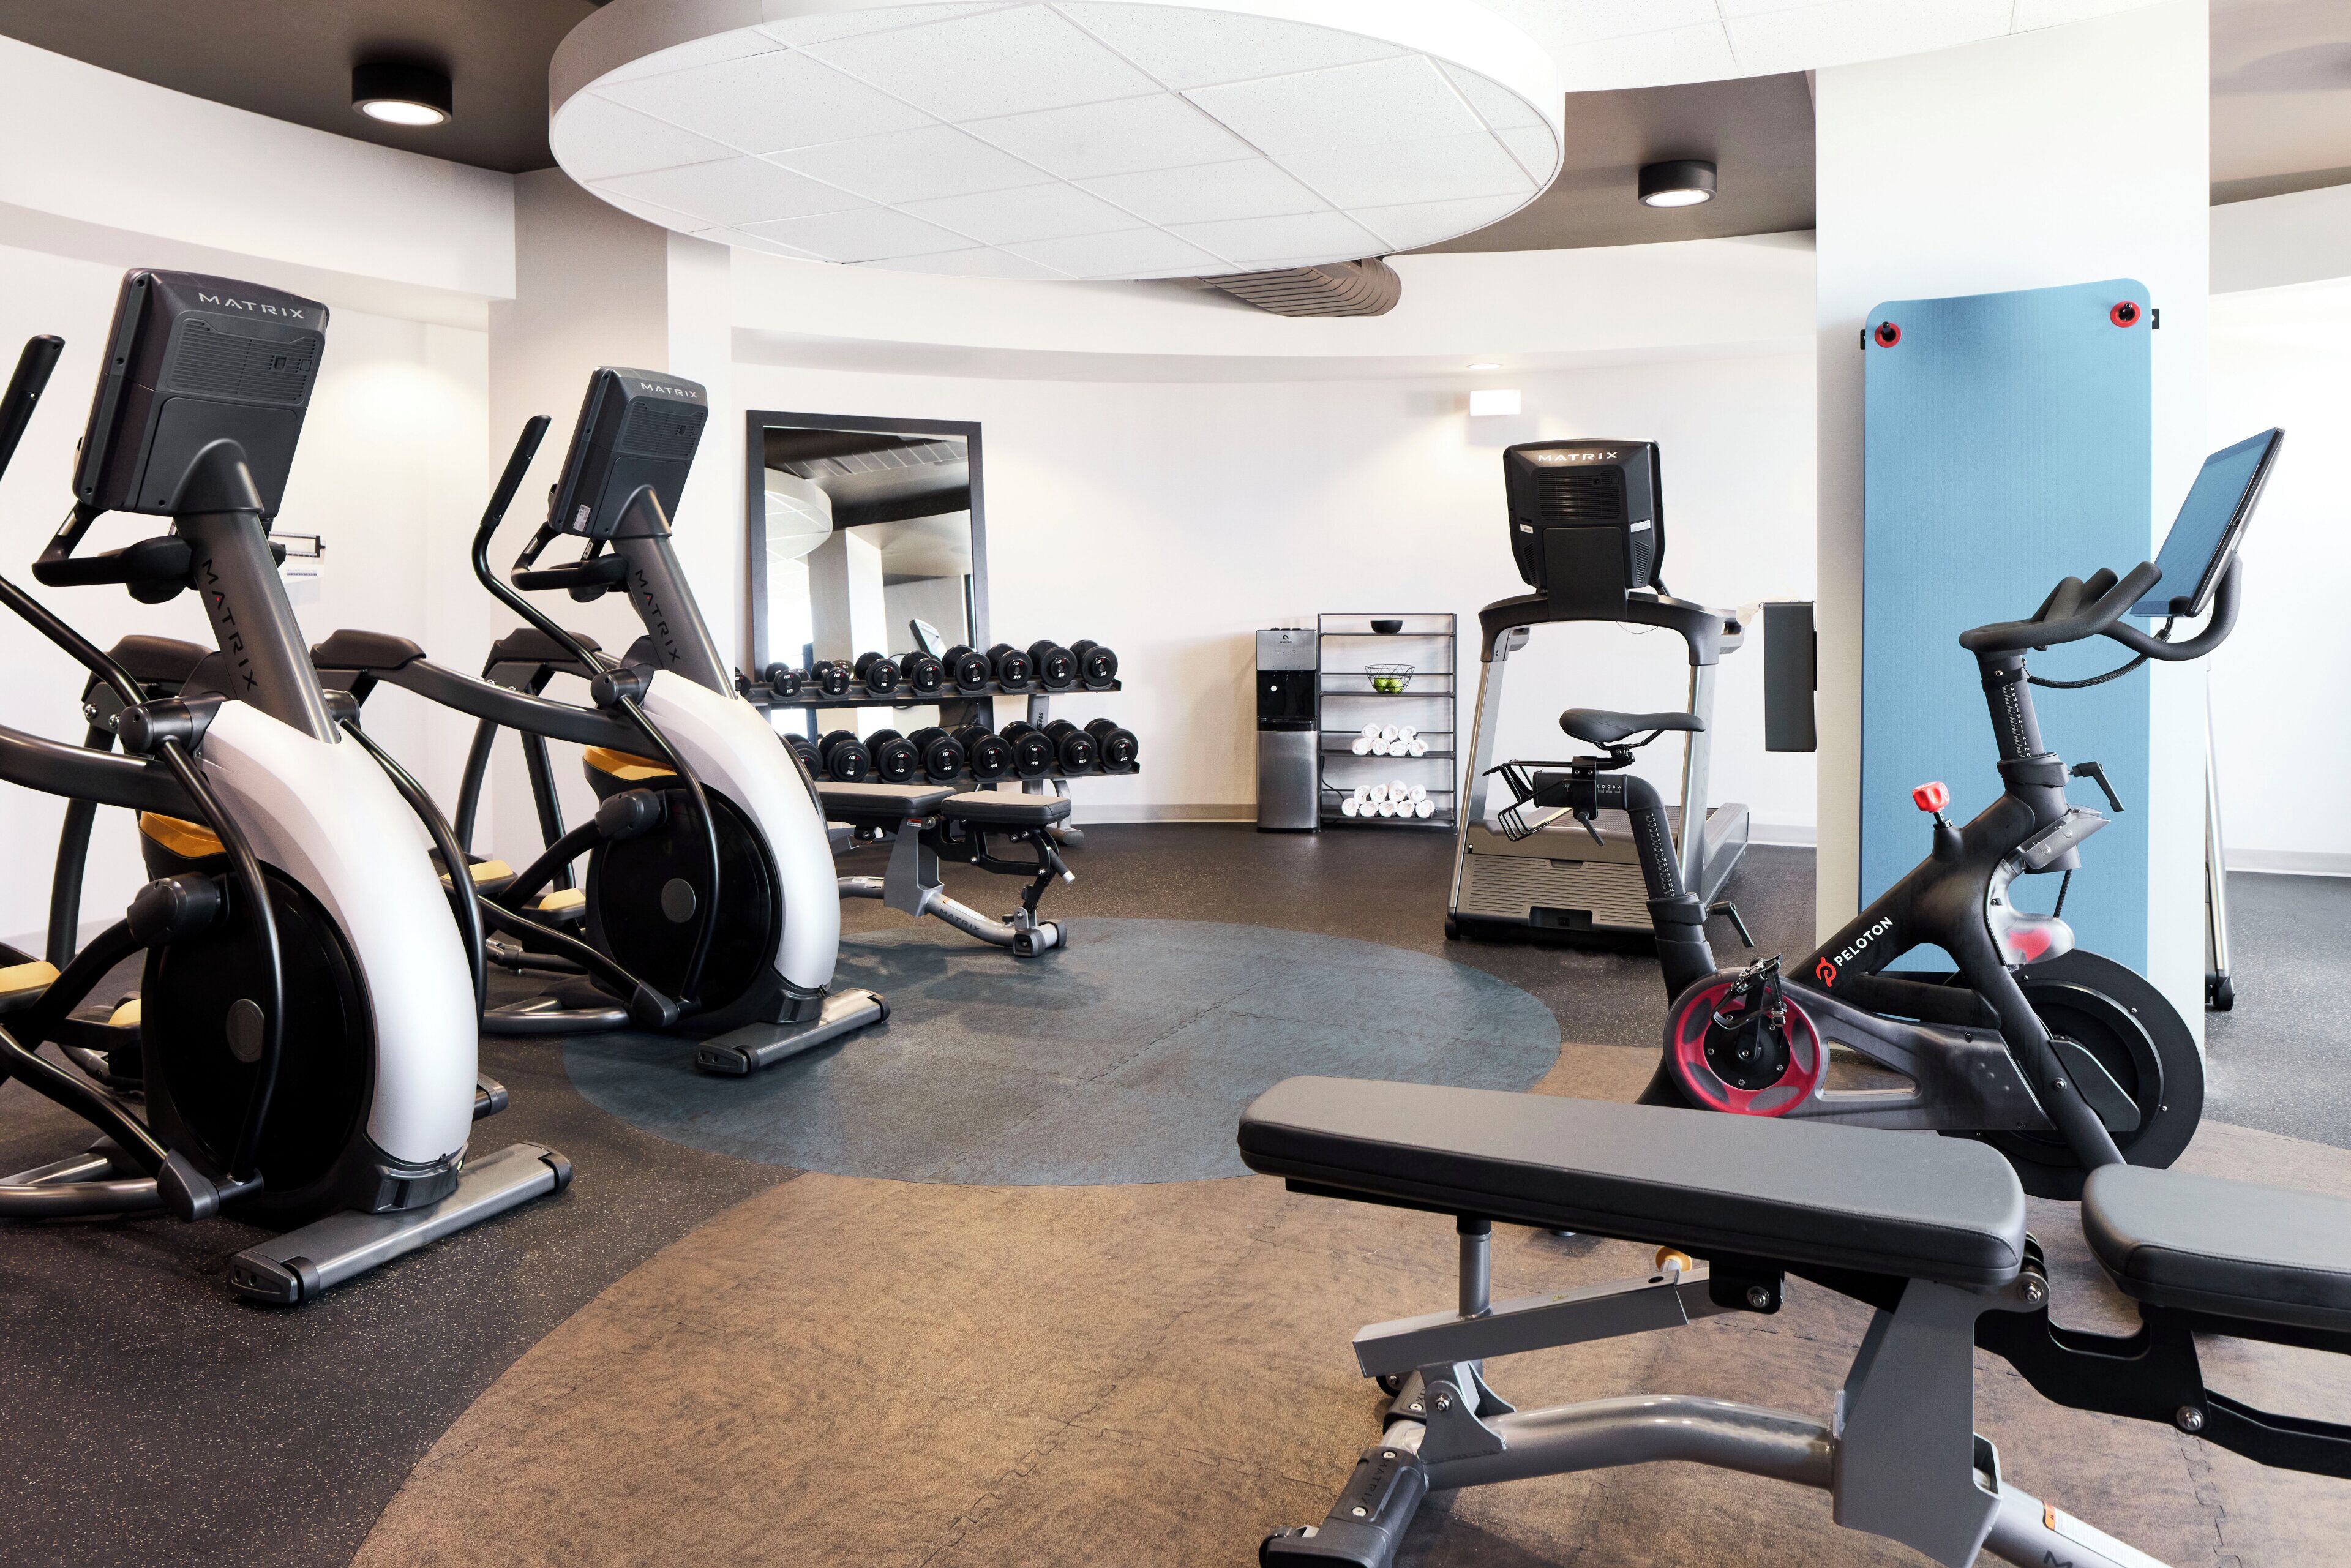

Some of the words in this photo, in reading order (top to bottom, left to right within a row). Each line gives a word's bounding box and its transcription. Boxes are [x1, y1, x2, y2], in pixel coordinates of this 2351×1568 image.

[198, 293, 304, 319] MATRIX
[640, 383, 697, 398] MATRIX
[1538, 451, 1618, 462] MATRIX
[202, 558, 258, 692] MATRIX
[635, 569, 681, 664] MATRIX
[940, 908, 980, 932] MATRIX
[1834, 916, 1893, 967] PELOTON
